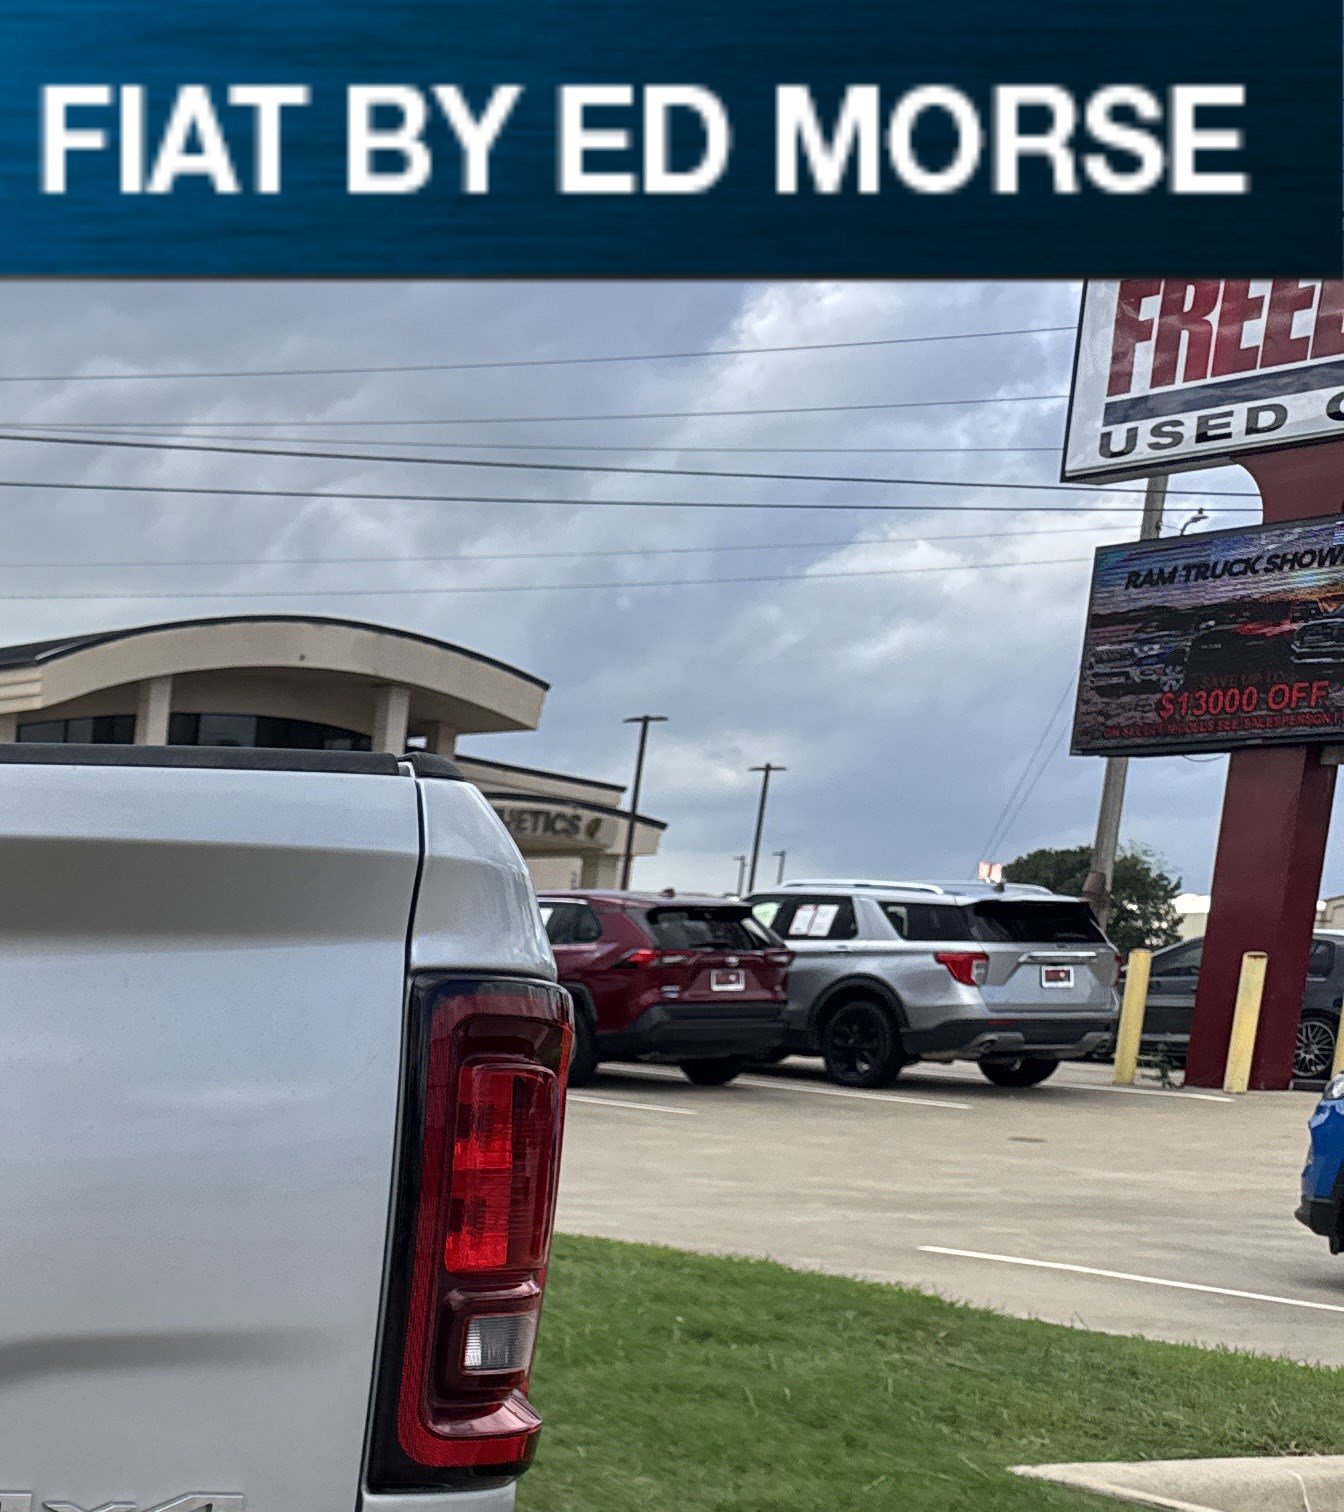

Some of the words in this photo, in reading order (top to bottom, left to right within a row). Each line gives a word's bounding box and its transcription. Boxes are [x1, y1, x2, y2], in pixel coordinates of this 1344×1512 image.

[1098, 403, 1289, 459] USED
[1125, 566, 1178, 590] RAM
[1181, 555, 1264, 584] TRUCK
[1159, 685, 1258, 721] $13000
[1266, 679, 1330, 712] OFF
